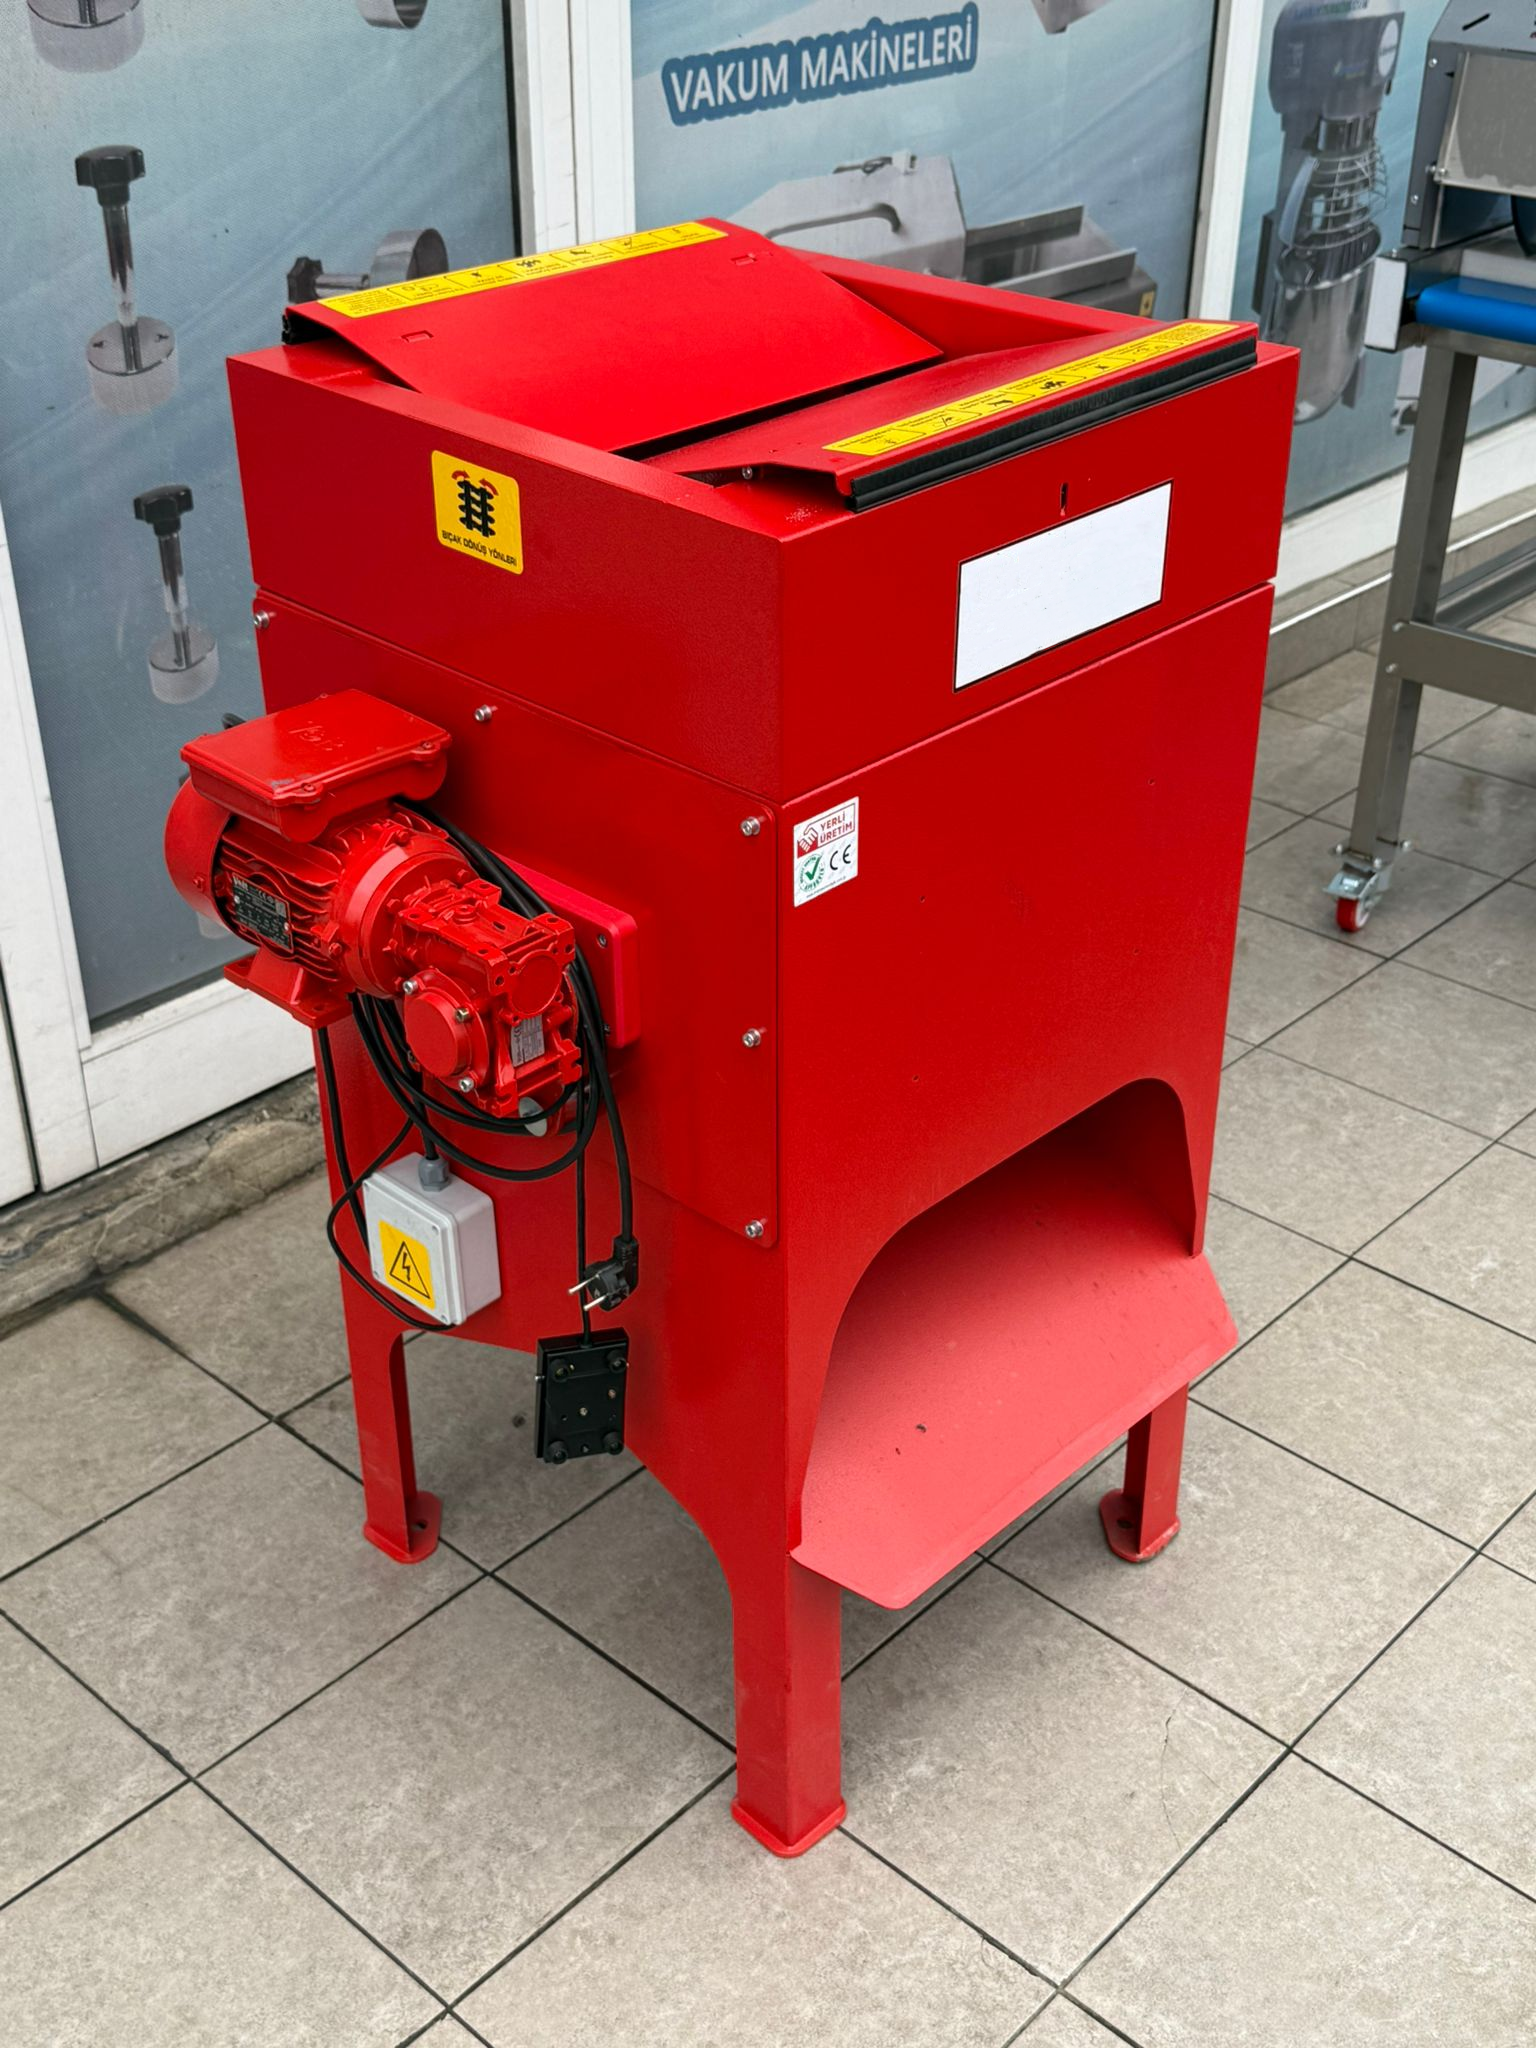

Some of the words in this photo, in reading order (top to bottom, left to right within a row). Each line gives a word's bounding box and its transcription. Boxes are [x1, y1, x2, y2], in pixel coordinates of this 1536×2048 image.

[670, 53, 788, 113] VAKUM
[801, 14, 973, 91] MAKİNELERİ
[820, 811, 846, 830] YERLİ
[820, 820, 853, 844] ÜRETİM
[829, 844, 851, 871] CE
